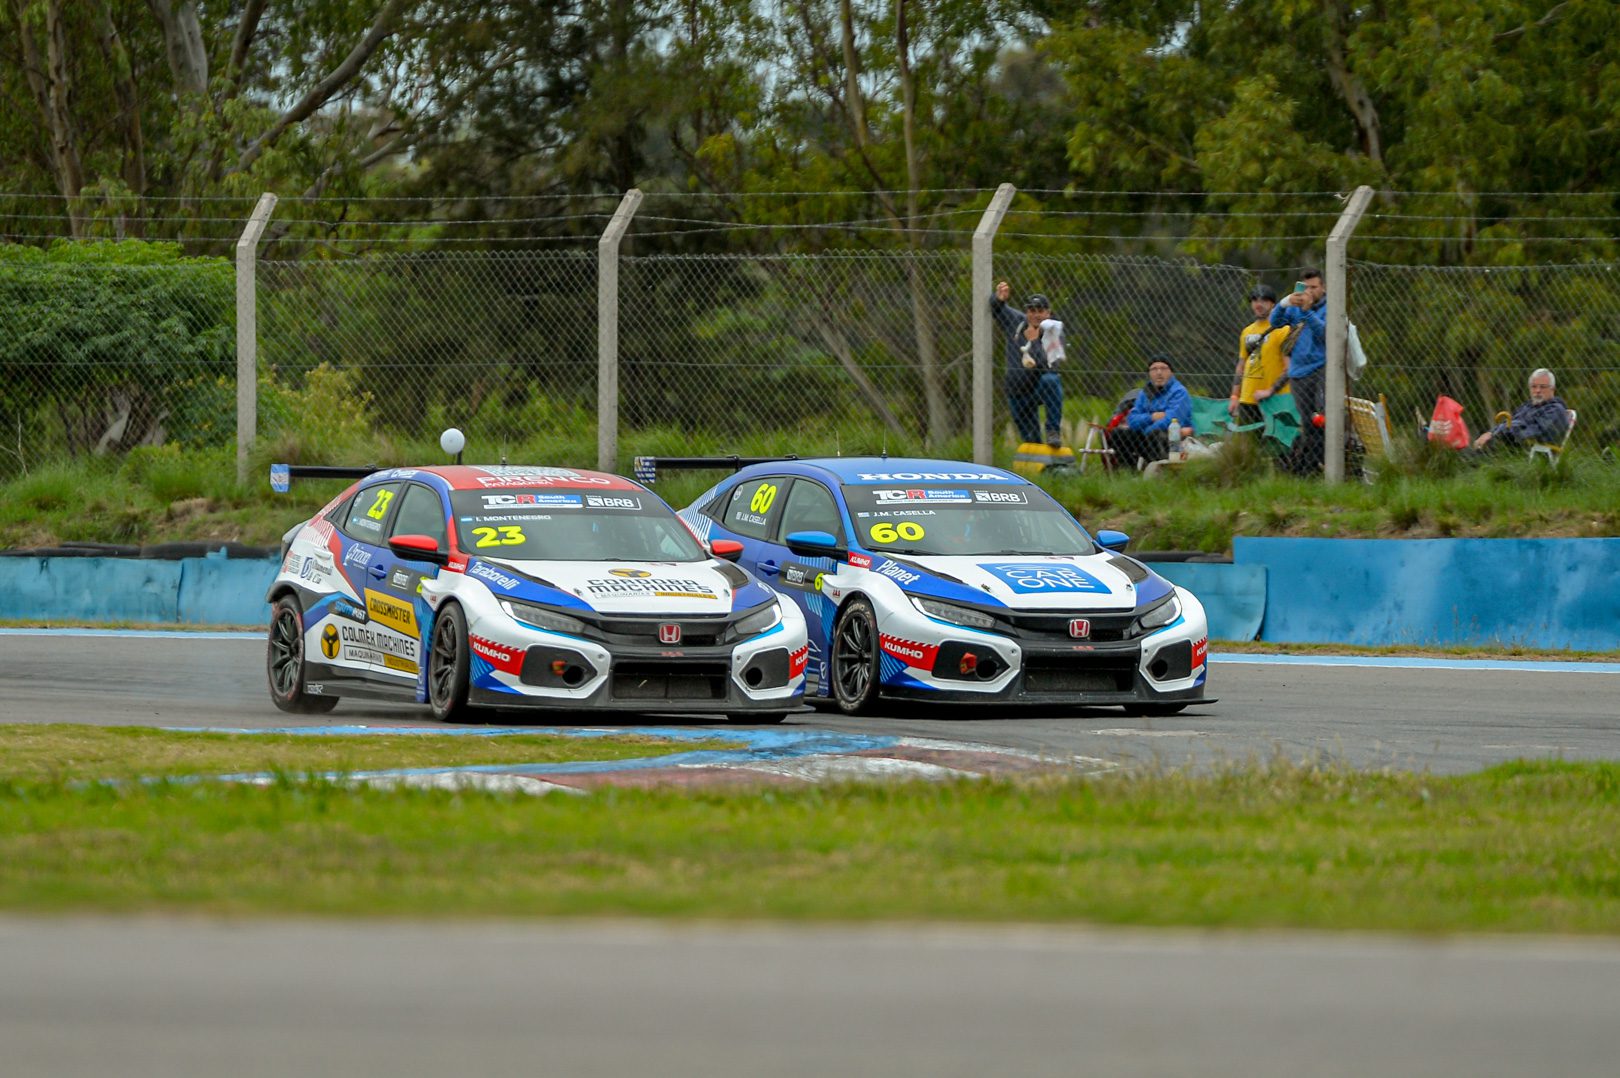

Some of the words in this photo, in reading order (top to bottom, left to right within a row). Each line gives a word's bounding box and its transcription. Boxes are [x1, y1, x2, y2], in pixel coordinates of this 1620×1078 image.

[857, 473, 1008, 481] HONDA
[481, 494, 536, 505] TCR
[604, 498, 634, 508] BRB
[750, 483, 777, 514] 60
[873, 489, 927, 499] TCR
[989, 492, 1021, 503] BRB
[366, 489, 395, 520] 23
[472, 526, 526, 548] 23
[870, 521, 925, 544] 60
[850, 556, 871, 566] KUMHO
[469, 561, 521, 590] Taraborelli
[876, 559, 921, 585] Planet
[1006, 570, 1082, 579] CAR
[587, 585, 714, 593] MACHINES
[1018, 578, 1095, 588] ONE
[370, 598, 411, 624] CROSSMASTER
[342, 626, 376, 647] COLMEX
[377, 633, 415, 657] MACHINES
[884, 641, 923, 659] KUMHO
[473, 642, 511, 662] KUMHO
